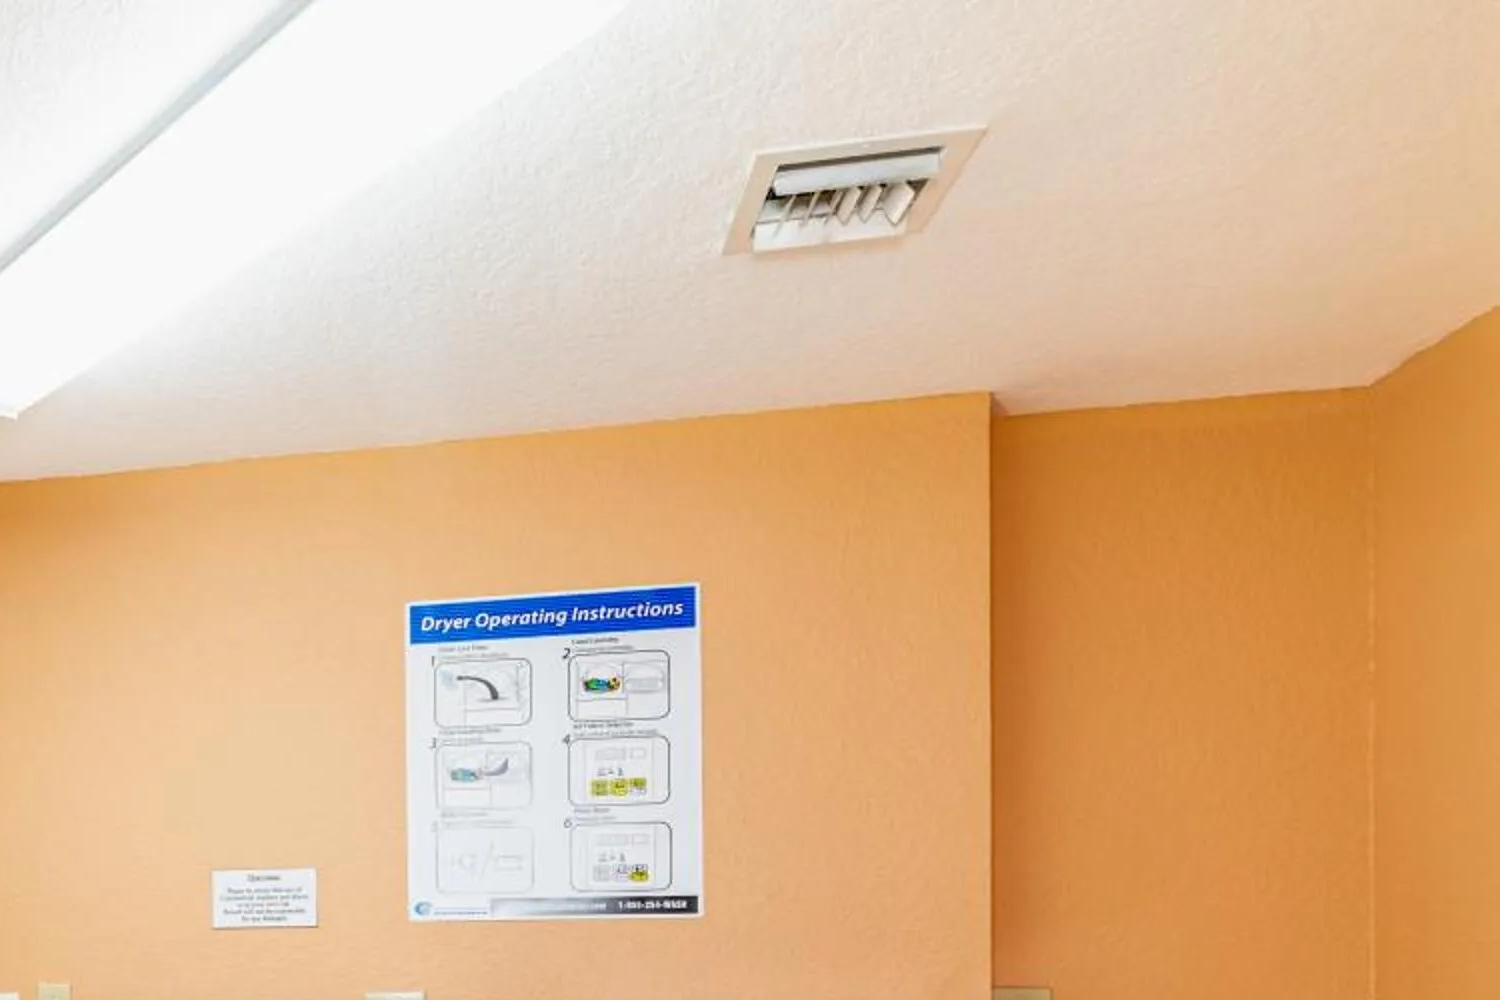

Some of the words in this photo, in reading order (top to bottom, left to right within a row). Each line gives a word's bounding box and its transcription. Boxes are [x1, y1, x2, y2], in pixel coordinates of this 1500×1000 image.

[420, 615, 470, 633] Dryer
[474, 608, 568, 629] Operating
[571, 600, 685, 622] Instructions
[562, 648, 572, 660] 2
